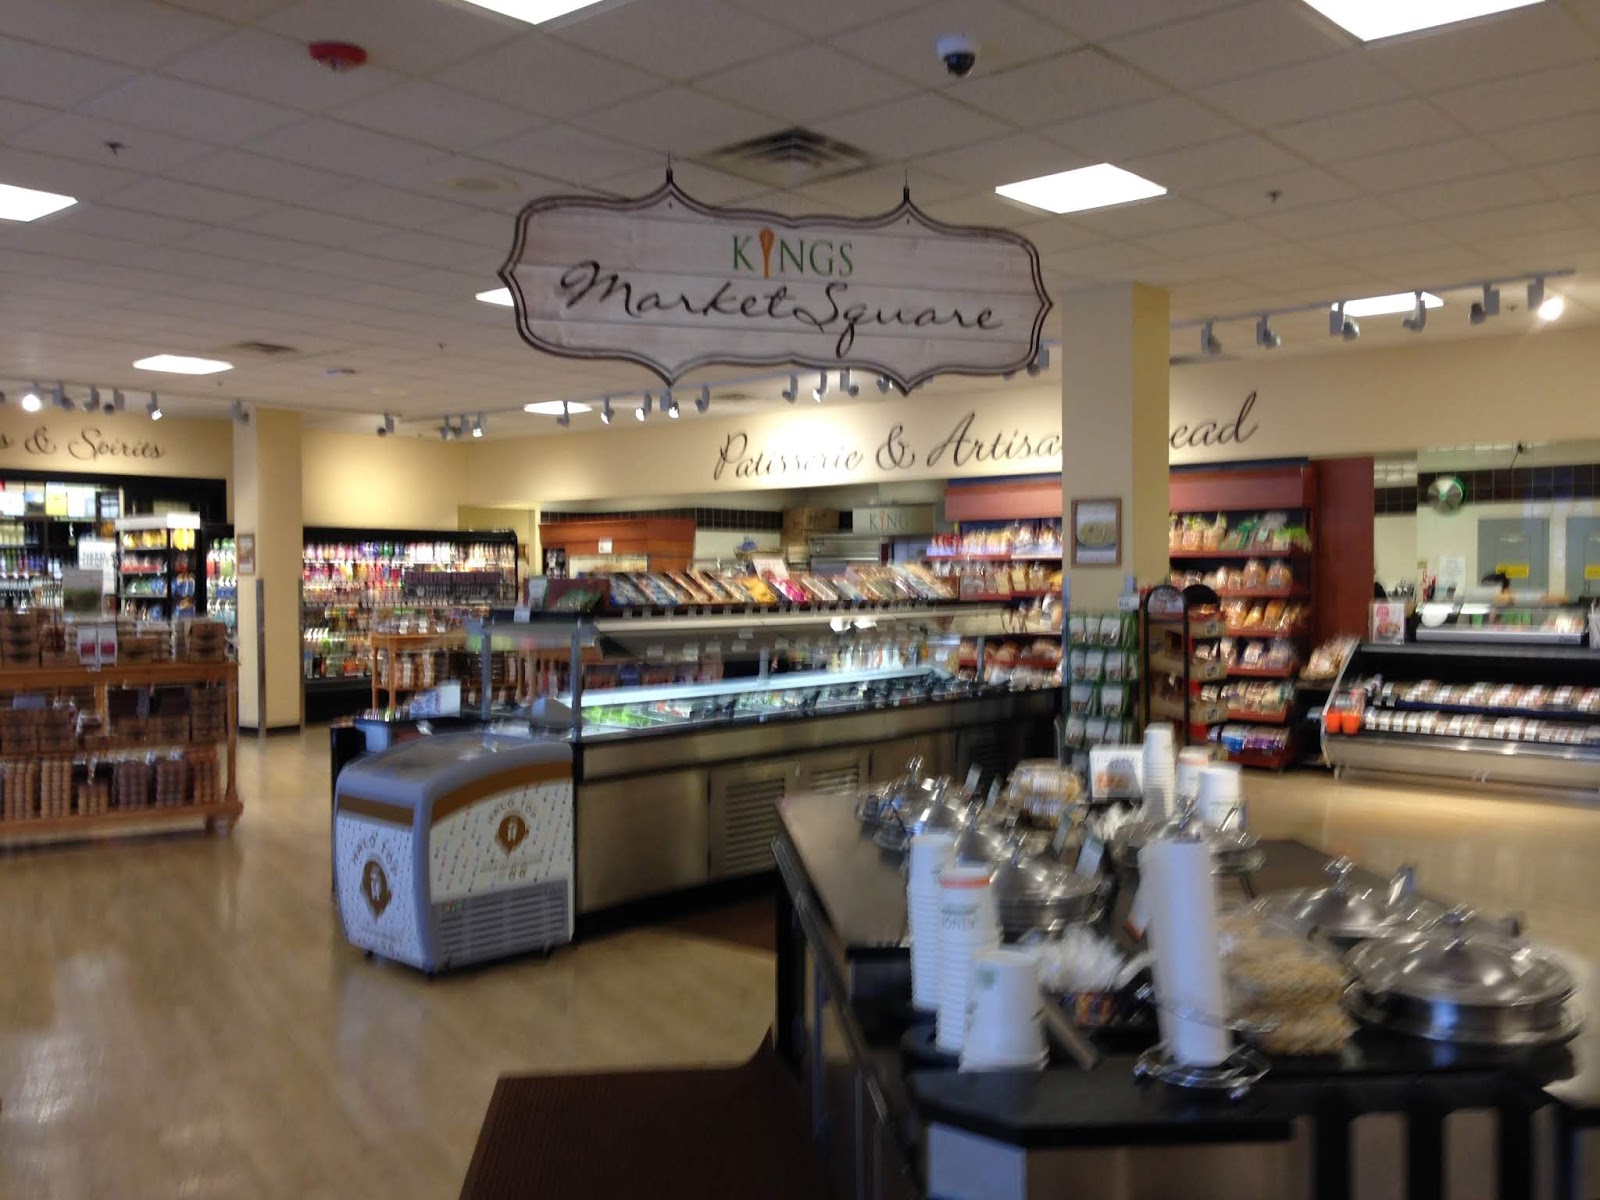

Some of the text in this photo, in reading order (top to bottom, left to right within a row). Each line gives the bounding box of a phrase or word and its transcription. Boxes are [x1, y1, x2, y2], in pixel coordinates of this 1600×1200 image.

[732, 227, 855, 279] KINGS
[560, 259, 1003, 358] Market Square
[874, 424, 916, 472] &
[926, 409, 1062, 468] Artisa
[1170, 388, 1261, 451] ead
